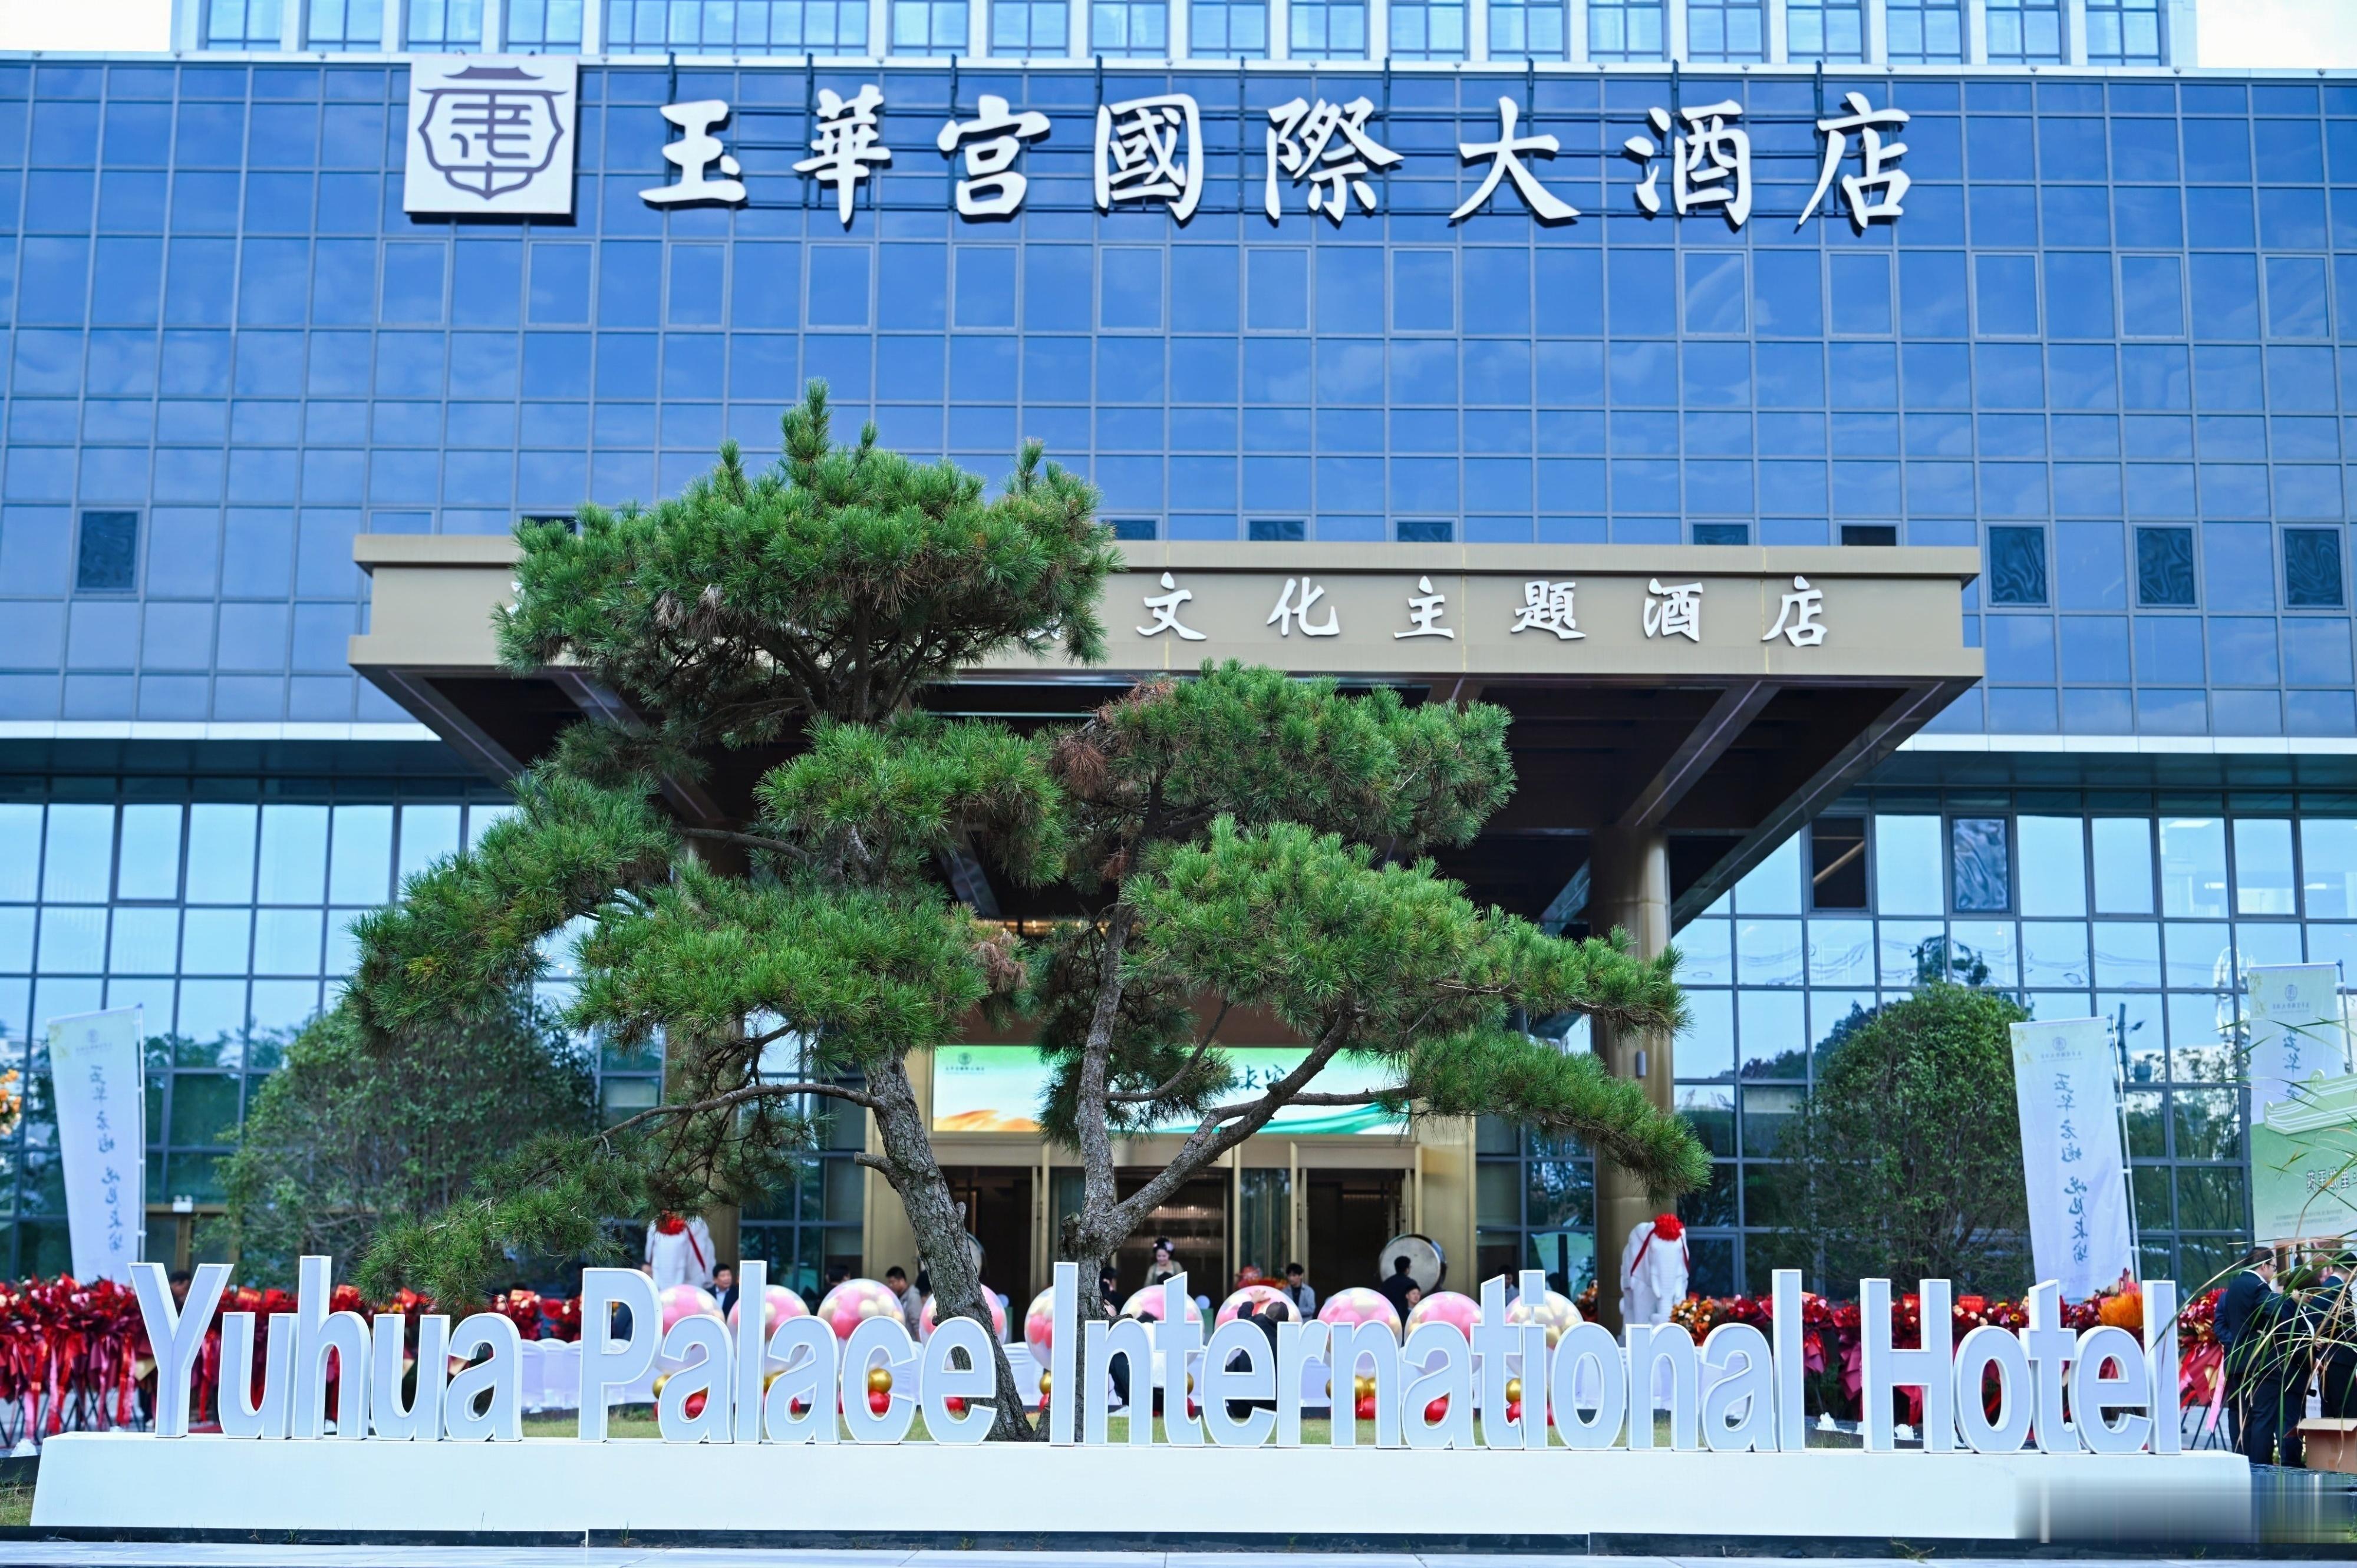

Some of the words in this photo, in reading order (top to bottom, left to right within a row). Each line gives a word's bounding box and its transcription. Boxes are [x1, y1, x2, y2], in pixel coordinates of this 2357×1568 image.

[127, 1255, 523, 1441] Yuhua
[578, 1260, 997, 1446] Palace
[1049, 1262, 1806, 1453] International
[1860, 1277, 2182, 1455] Hotel
